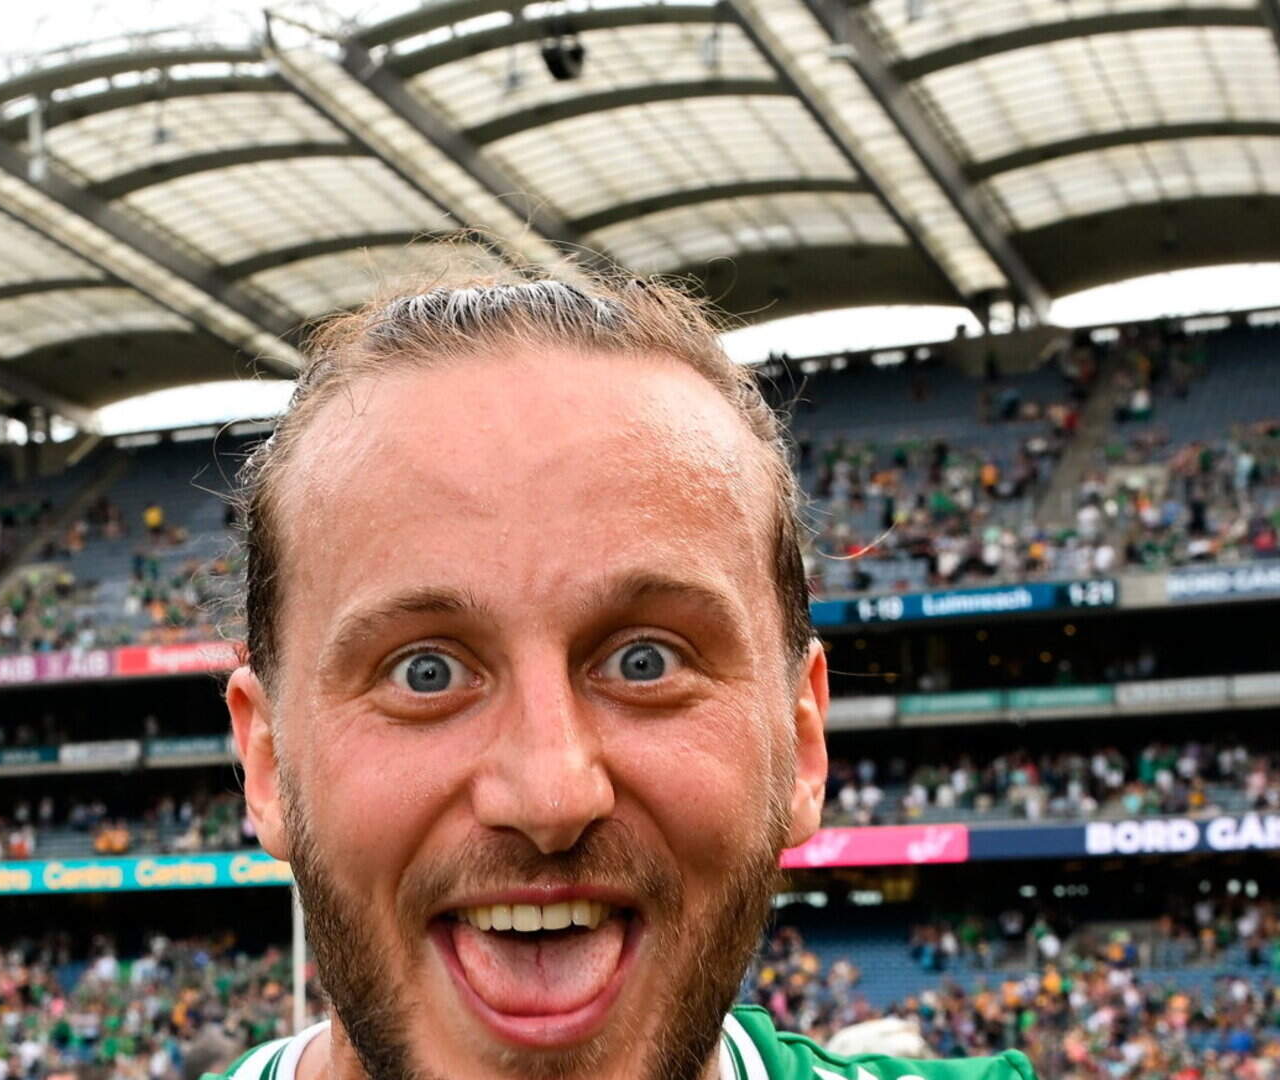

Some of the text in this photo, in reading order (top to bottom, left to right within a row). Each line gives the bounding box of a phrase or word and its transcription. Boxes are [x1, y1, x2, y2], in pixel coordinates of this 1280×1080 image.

[1086, 818, 1198, 855] BORD
[43, 862, 123, 890] Centra
[135, 859, 217, 886] Centra
